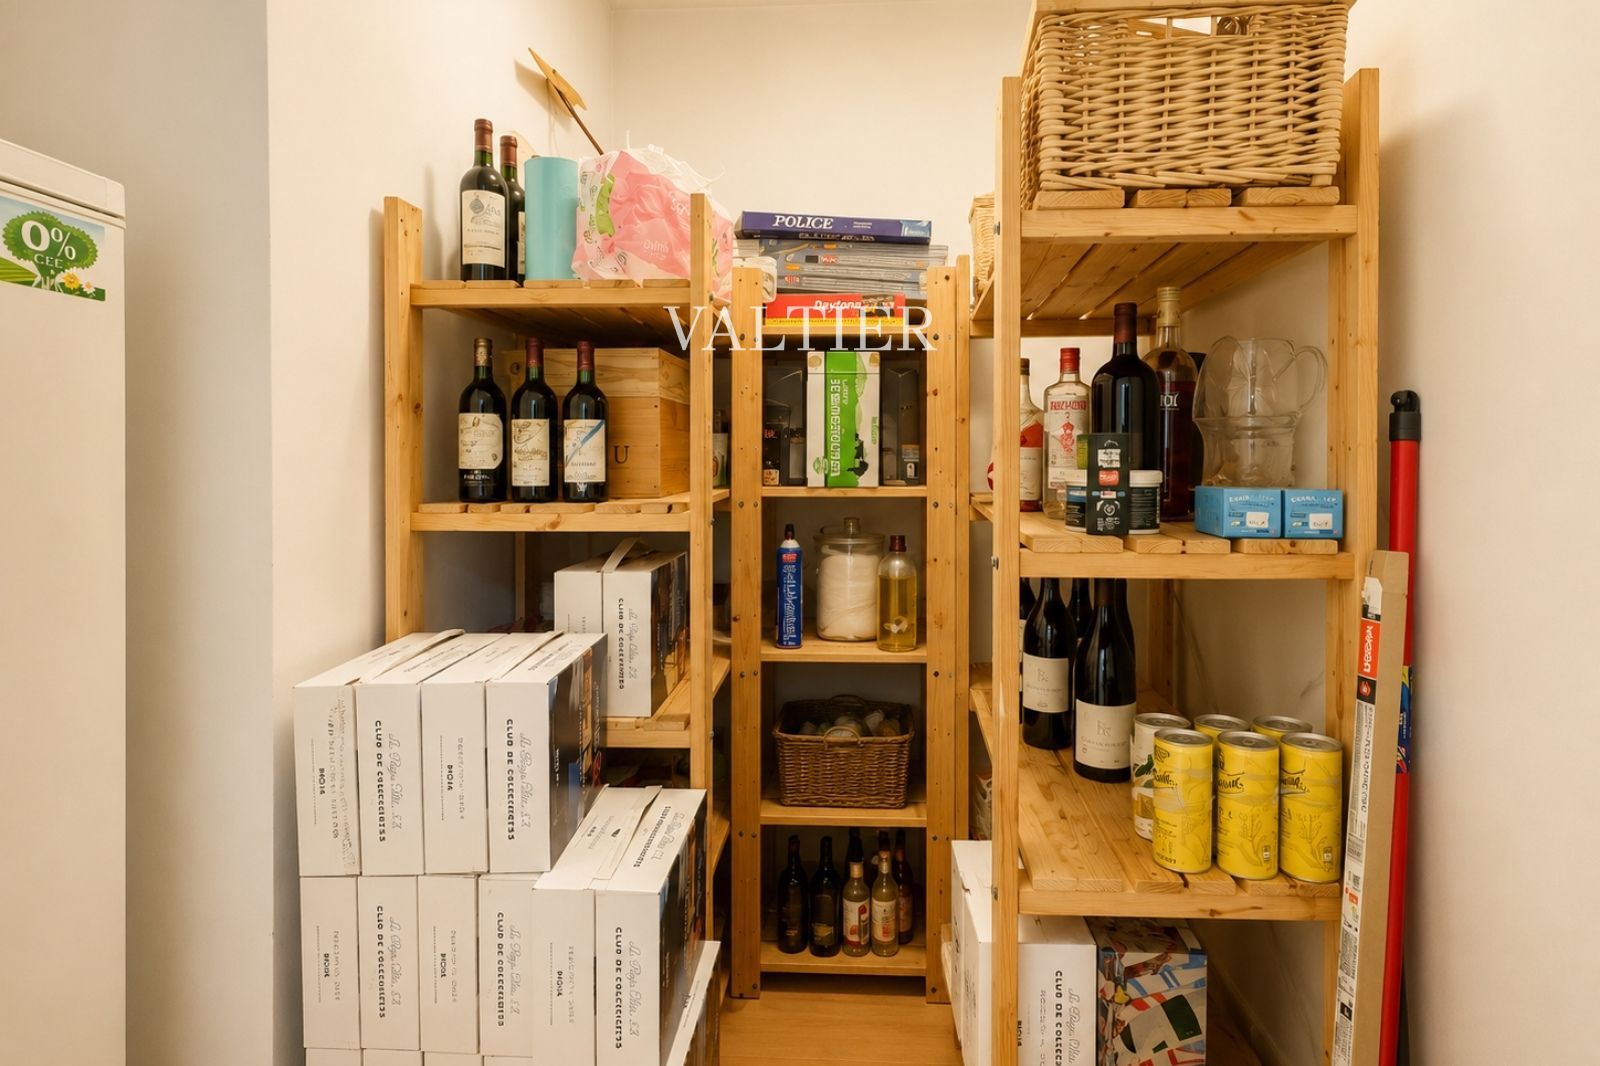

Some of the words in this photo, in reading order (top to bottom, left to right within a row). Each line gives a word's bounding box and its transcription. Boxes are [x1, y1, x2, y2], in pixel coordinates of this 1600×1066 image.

[773, 215, 834, 230] POLICE
[21, 220, 76, 260] 0%
[814, 300, 862, 313] Daytona
